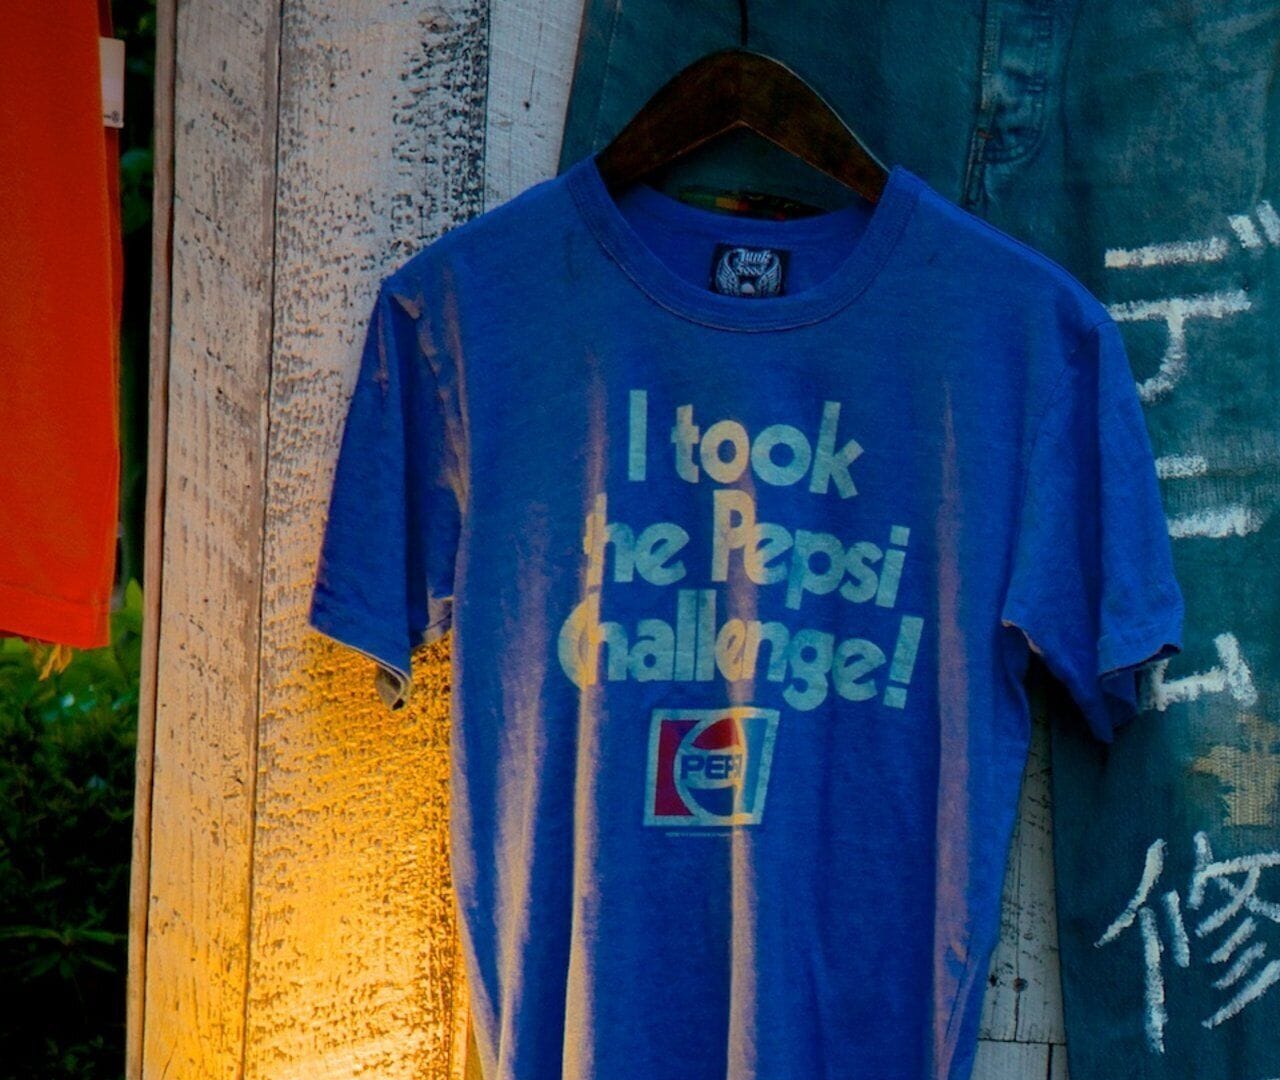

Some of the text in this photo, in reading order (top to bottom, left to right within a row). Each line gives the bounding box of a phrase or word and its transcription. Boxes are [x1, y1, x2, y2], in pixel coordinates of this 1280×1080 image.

[627, 389, 865, 500] I took
[710, 488, 911, 611] Pepsi
